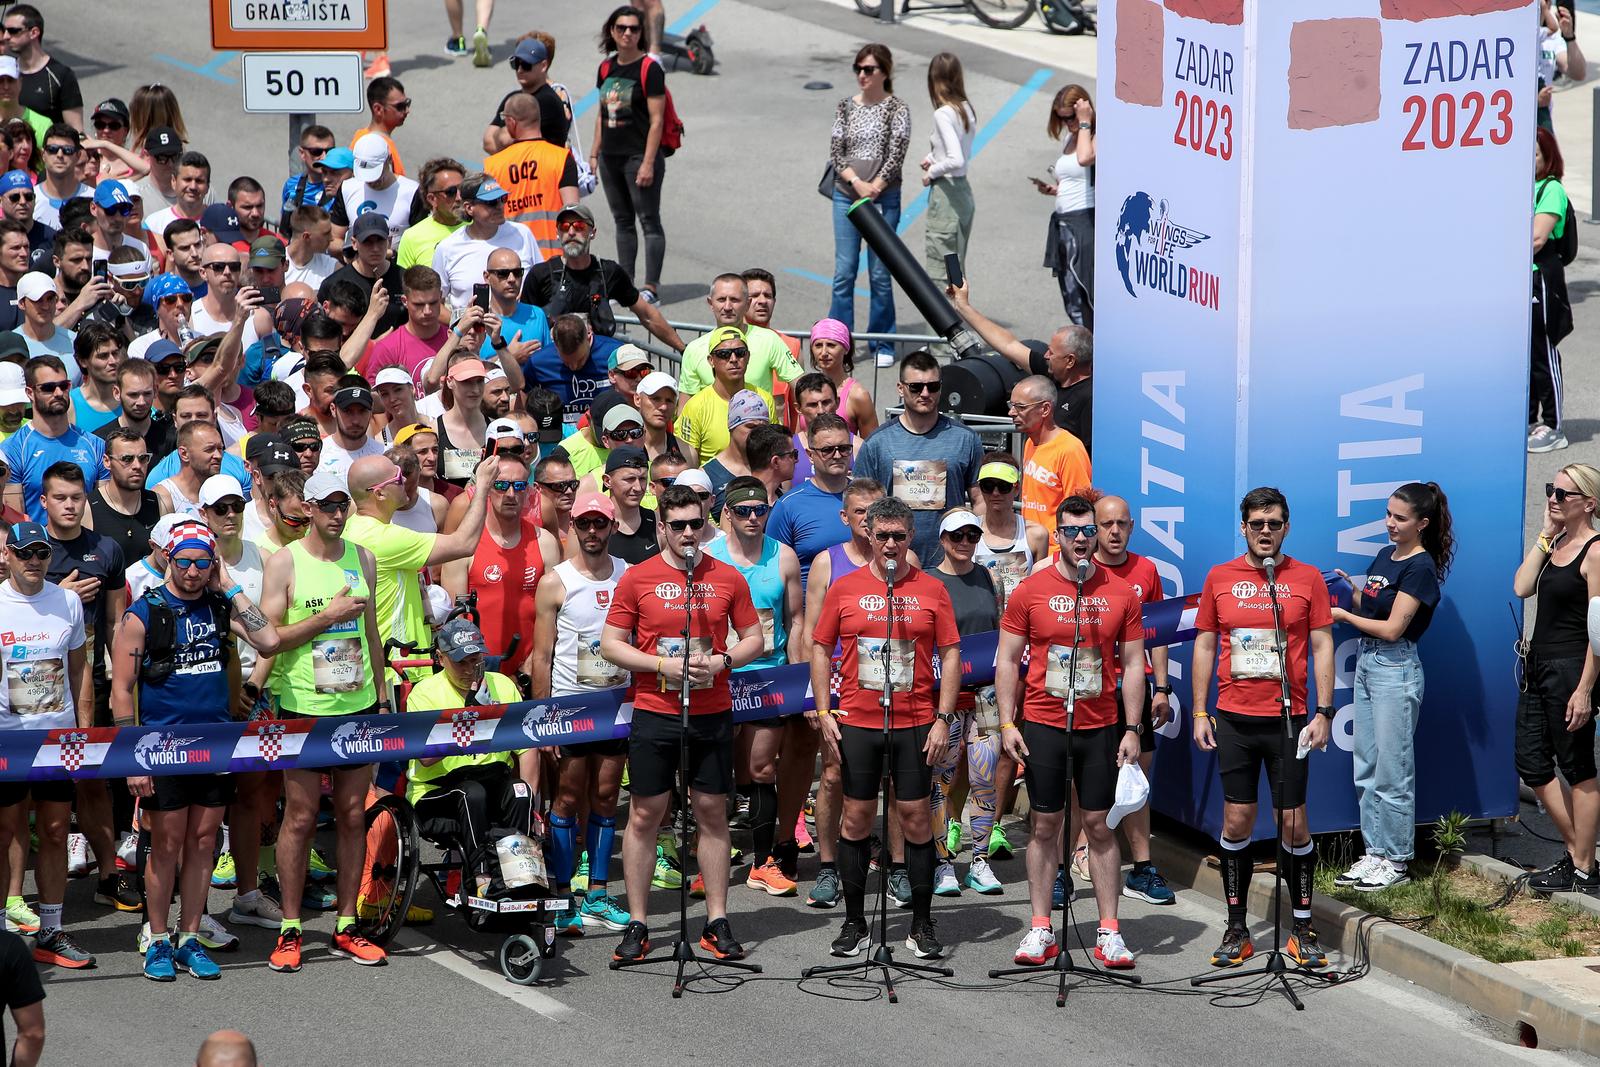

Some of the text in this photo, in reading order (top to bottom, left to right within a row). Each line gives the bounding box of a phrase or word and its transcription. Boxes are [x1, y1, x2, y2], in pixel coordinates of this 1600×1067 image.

[1175, 37, 1234, 95] ZADAR
[1403, 37, 1515, 85] ZADAR
[266, 70, 339, 96] 50 m
[1174, 90, 1233, 161] 2023
[1401, 89, 1513, 151] 2023
[1150, 219, 1187, 245] WINGS
[1154, 239, 1176, 259] LIFE
[2, 631, 50, 646] Zadarski
[331, 667, 352, 675] 49247
[1246, 657, 1268, 665] 51375
[732, 696, 762, 712] ORLD
